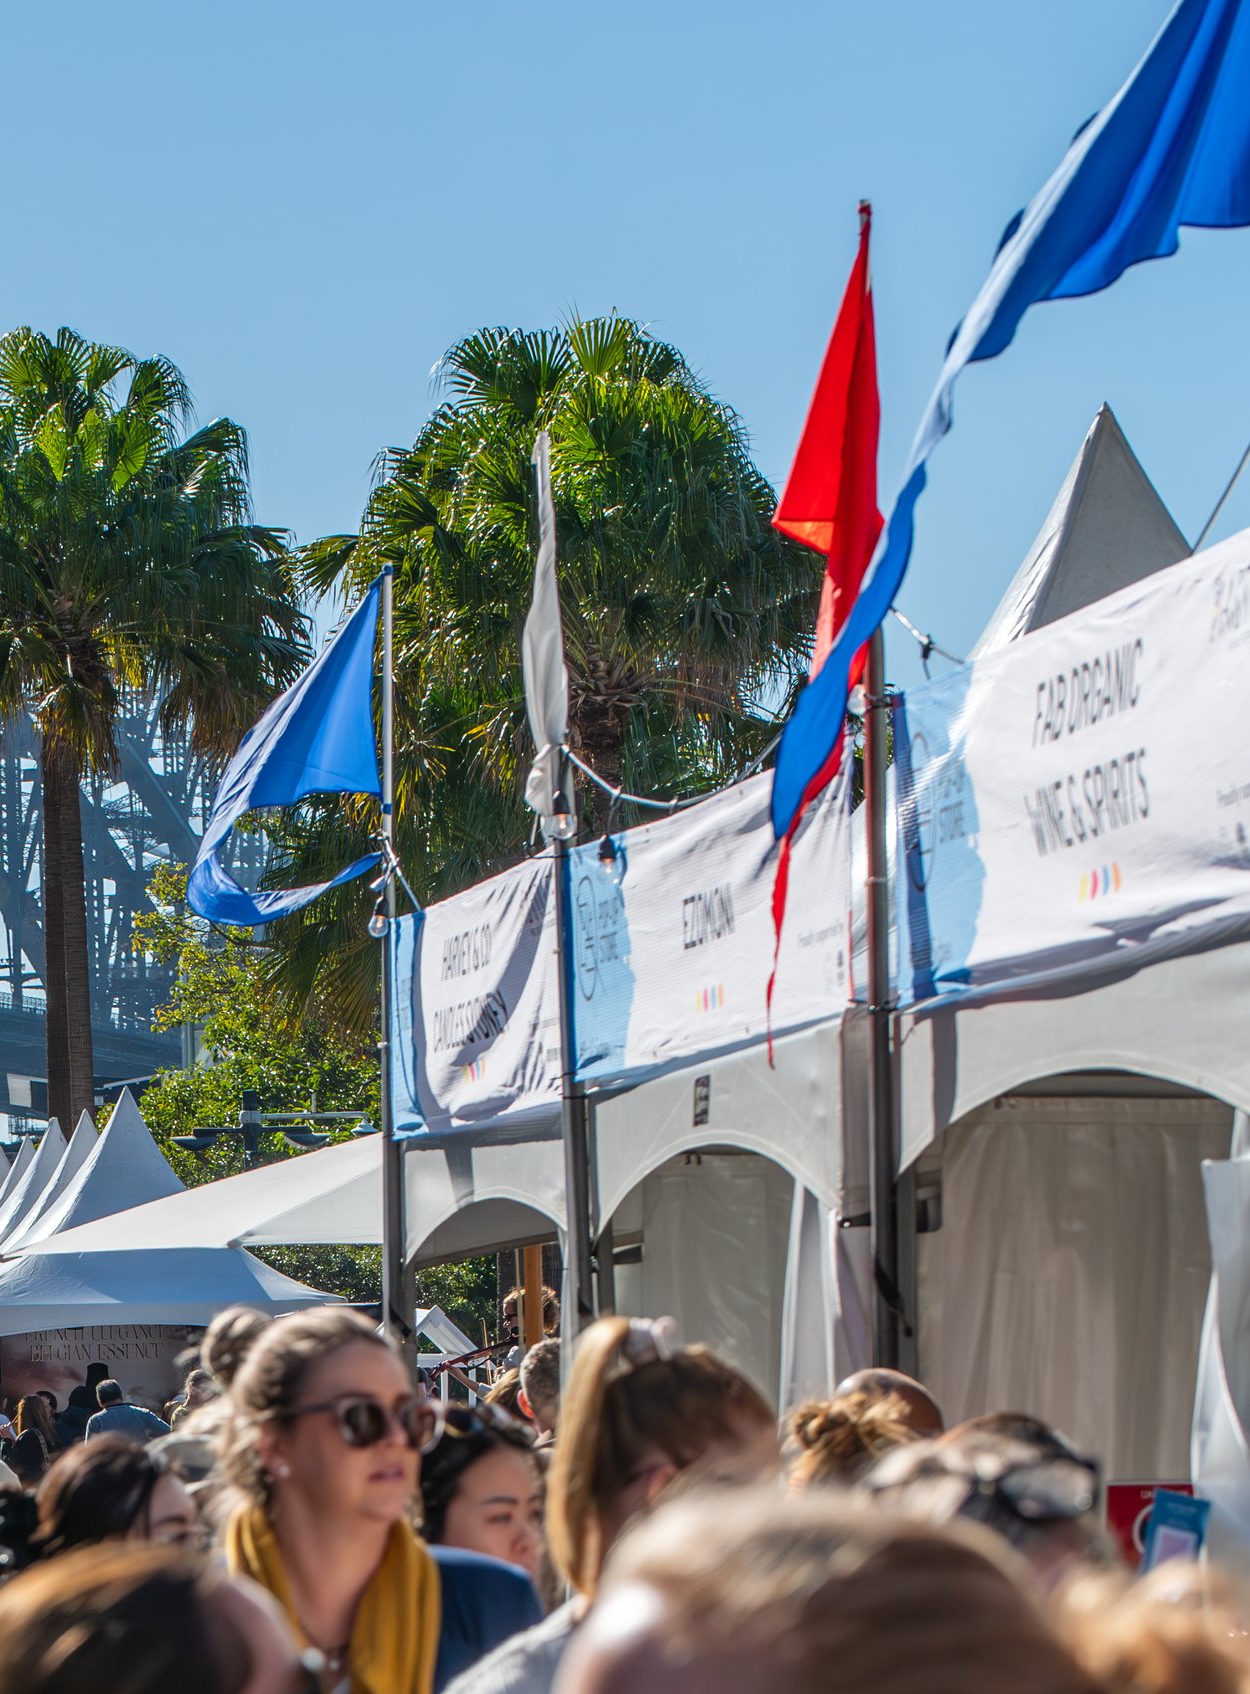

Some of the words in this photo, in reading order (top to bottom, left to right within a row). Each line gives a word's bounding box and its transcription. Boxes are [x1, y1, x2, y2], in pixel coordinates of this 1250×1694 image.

[1032, 673, 1066, 748] FAB
[1067, 638, 1143, 736] ORGANIC
[1023, 774, 1074, 858] WINE
[1082, 747, 1150, 839] SPIRITS
[441, 930, 472, 982] HARVEY
[30, 1343, 92, 1361] BELGIAN
[97, 1342, 165, 1361] ESSENCE
